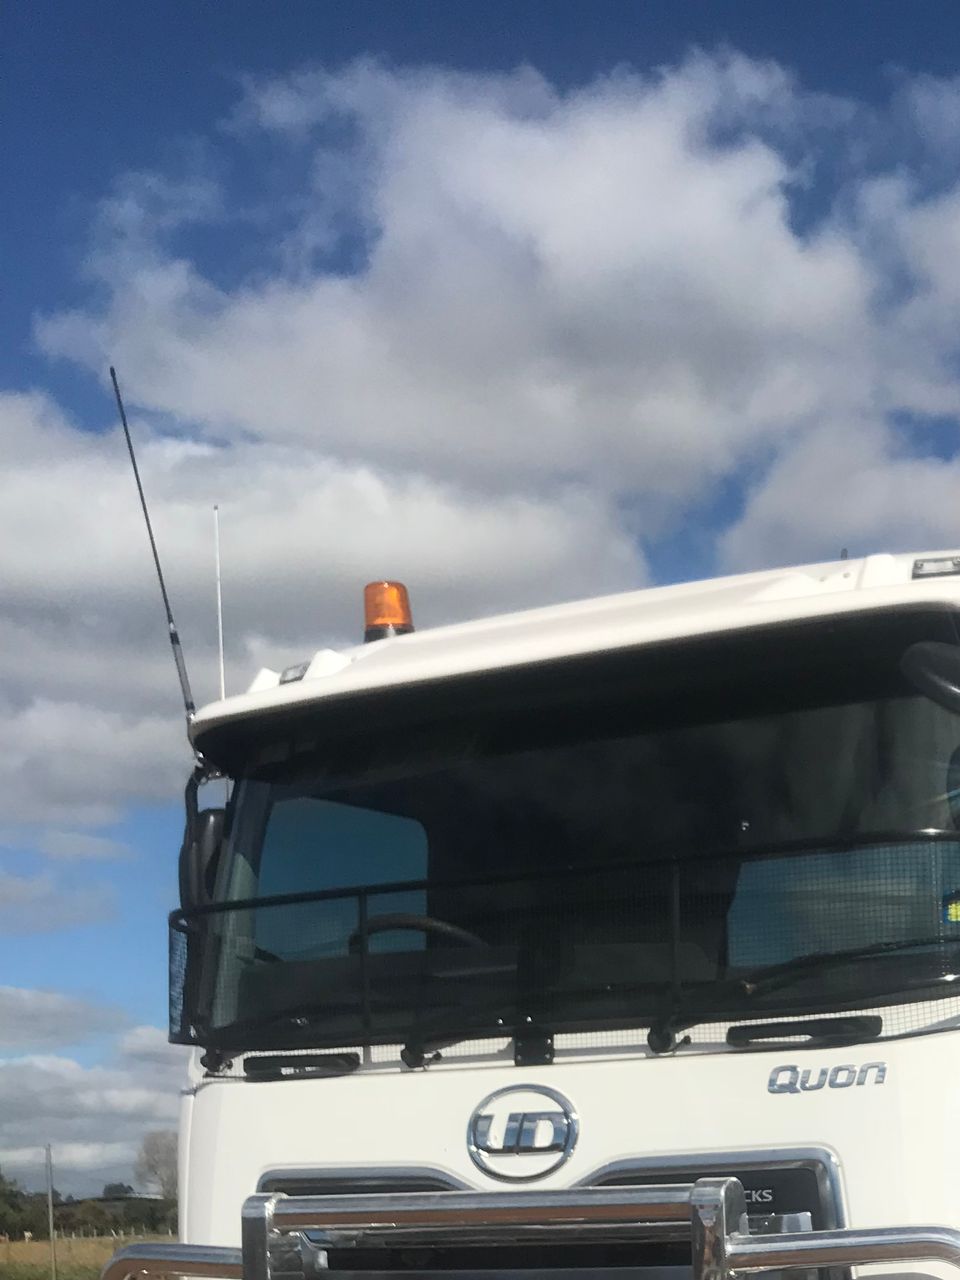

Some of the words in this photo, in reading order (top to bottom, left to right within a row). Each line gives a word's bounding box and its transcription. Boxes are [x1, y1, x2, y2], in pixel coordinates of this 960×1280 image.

[767, 1061, 888, 1095] Quon
[473, 1111, 571, 1154] UD
[744, 1189, 773, 1202] CKS
